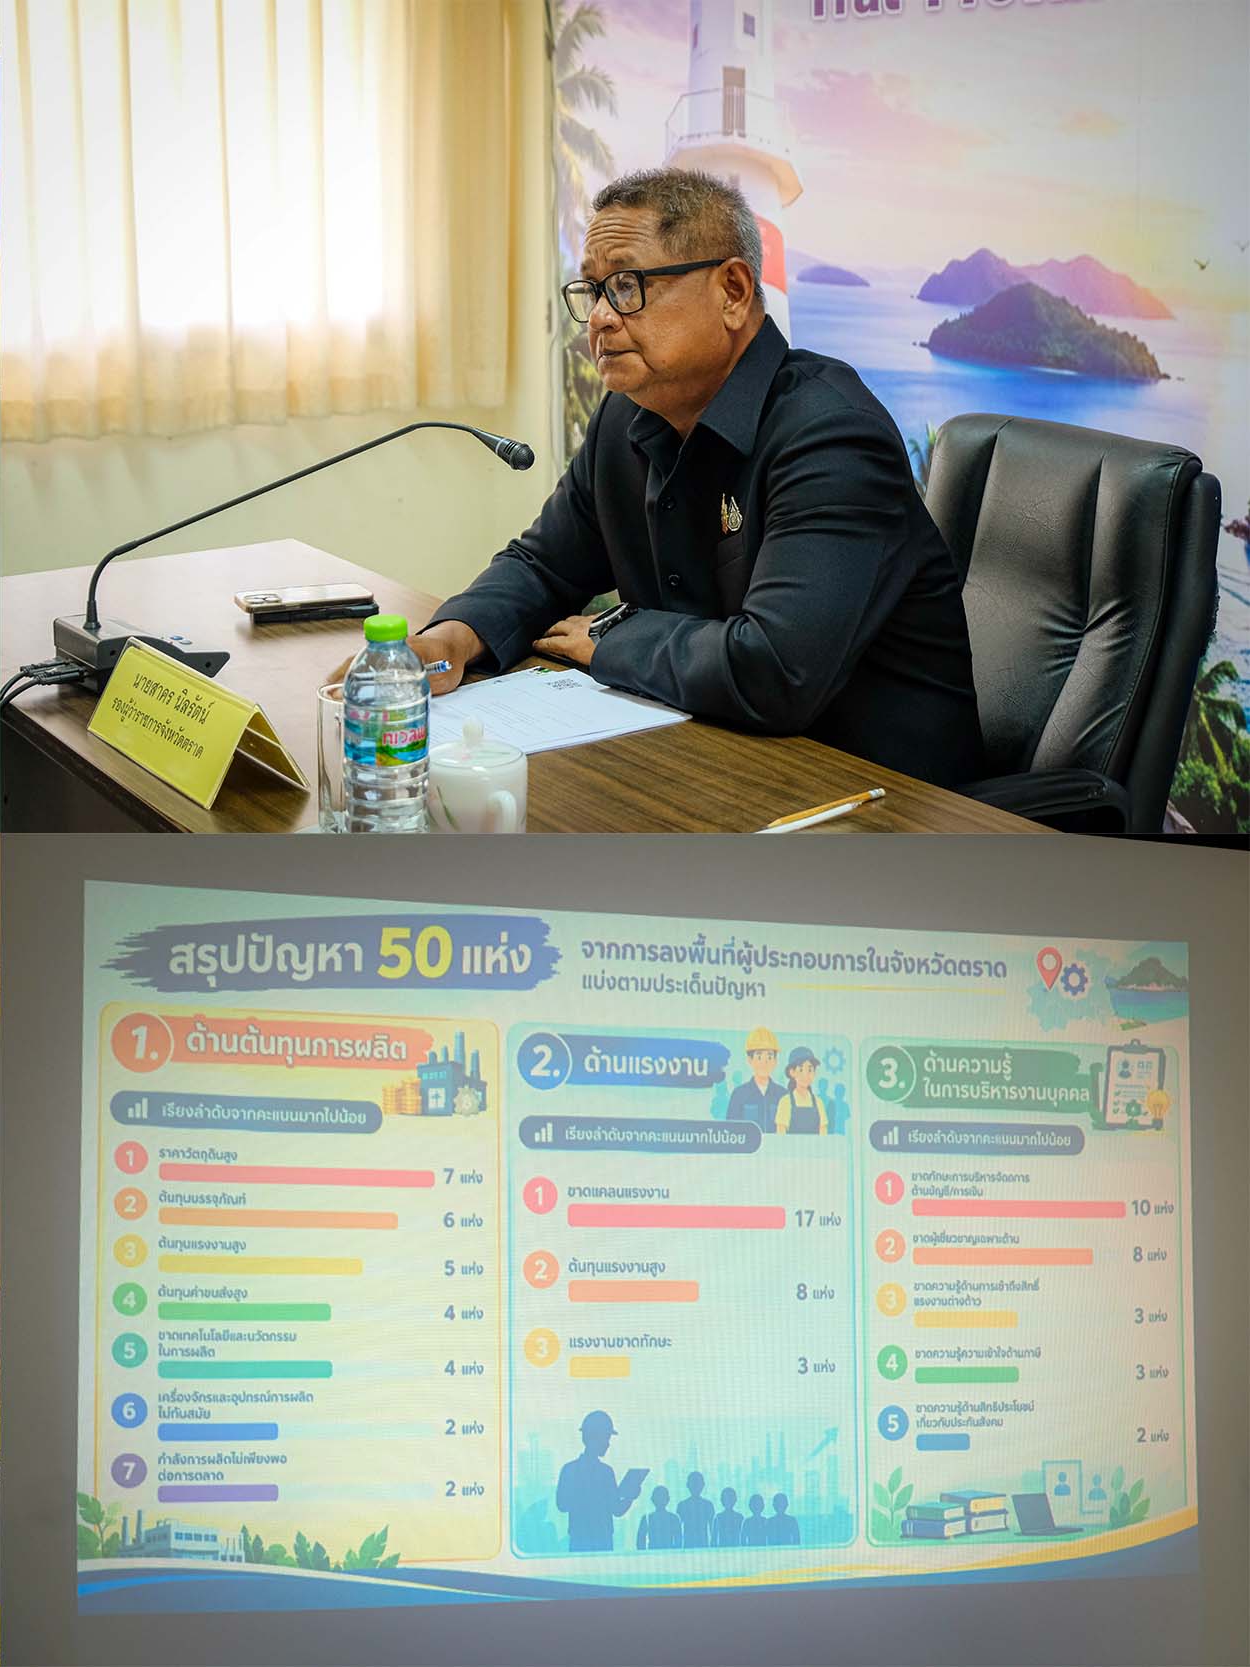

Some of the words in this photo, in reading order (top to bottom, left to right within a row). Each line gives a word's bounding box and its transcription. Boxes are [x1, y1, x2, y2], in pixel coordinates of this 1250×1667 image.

[133, 673, 175, 705] นายสาคร
[174, 688, 216, 724] นิลรัตน์
[111, 697, 204, 759] รองผู้ว่าราชการจังหวัดตราด
[170, 933, 363, 987] สรุปปัญหา
[377, 926, 453, 979] 50
[462, 931, 532, 976] แห่ง
[581, 933, 1007, 978] จากการลงพื้นที่ผู้ประกอบการในจังหวัดตราด
[582, 969, 766, 1000] แบ่งตามประเด็นปัญหา
[131, 1025, 159, 1060] 1.
[186, 1022, 408, 1065] ด้านต้นทุนการผลิต
[530, 1044, 560, 1077] 2.
[584, 1046, 708, 1077] ด้านแรงงาน
[924, 1050, 1013, 1081] ด้านความรู้
[878, 1057, 905, 1089] 3.
[923, 1077, 1090, 1107] ในการบริหารงานบุคคล
[161, 1102, 366, 1125] เรียงลำดับจากคะแนนมากไปน้อย
[565, 1127, 746, 1145] เรียงลำดับจากคะแนนมากไปน้อย
[908, 1129, 1071, 1147] เรียงลำดับจากคะแนนมากไปน้อย
[126, 1150, 135, 1166] 1
[159, 1147, 238, 1164] ราคาวัตถุดิบสูง
[443, 1168, 454, 1184] 7
[460, 1169, 483, 1184] แห่ง
[885, 1179, 893, 1197] 1
[912, 1171, 1030, 1183] ขาดทักษะการบริหารจัดการ
[534, 1186, 543, 1206] 1
[568, 1185, 670, 1199] ขาดแคลนแรงงาน
[912, 1185, 983, 1198] ด้านบัญชี/การเงิน
[124, 1196, 137, 1213] 2
[158, 1190, 247, 1208] ต้นทุนบรรจุภัณฑ์
[1132, 1199, 1151, 1216] 10
[1154, 1200, 1174, 1215] แห่ง
[443, 1212, 455, 1228] 6
[460, 1213, 483, 1227] แห่ง
[795, 1210, 815, 1228] 17
[819, 1211, 842, 1227] แห่ง
[124, 1242, 136, 1259] 3
[158, 1236, 247, 1254] ต้นทุนแรงงานสูง
[885, 1238, 896, 1256] 2
[913, 1230, 1020, 1246] ขาดผู้เชี่ยวชาญเฉพาะด้าน
[1133, 1246, 1143, 1262] 8
[1147, 1248, 1167, 1261] แห่ง
[444, 1260, 455, 1276] 5
[461, 1262, 484, 1275] แห่ง
[534, 1260, 548, 1280] 2
[568, 1258, 666, 1277] ต้นทุนแรงงานสูง
[122, 1291, 136, 1308] 4
[158, 1284, 248, 1302] ต้นทุนค่าขนส่งสูง
[796, 1283, 808, 1300] 8
[813, 1285, 835, 1300] แห่ง
[884, 1291, 897, 1308] 3
[914, 1296, 982, 1307] แรงงานต่างด้าว
[444, 1304, 455, 1320] 4
[461, 1306, 484, 1319] แห่ง
[1135, 1308, 1144, 1324] 3
[1148, 1308, 1167, 1322] แห่ง
[124, 1342, 136, 1359] 5
[158, 1328, 297, 1343] ขาดเทคโนโลยีและนวัตกรรม
[158, 1344, 216, 1358] ในการผลิต
[535, 1338, 548, 1358] 3
[569, 1333, 672, 1349] แรงงานขาดทักษะ
[444, 1360, 456, 1376] 4
[461, 1361, 484, 1375] แห่ง
[797, 1357, 808, 1374] 3
[814, 1358, 836, 1374] แห่ง
[885, 1353, 898, 1371] 4
[1136, 1364, 1145, 1380] 3
[1150, 1365, 1168, 1378] แห่ง
[122, 1402, 136, 1419] 6
[158, 1388, 314, 1406] เครื่องจักรและอุปกรณ์การผลิต
[158, 1406, 211, 1420] ไม่ทันสมัย
[445, 1419, 456, 1435] 2
[462, 1420, 484, 1435] แห่ง
[887, 1414, 898, 1432] 5
[1137, 1427, 1146, 1442] 2
[1150, 1428, 1169, 1442] แห่ง
[122, 1462, 136, 1480] 7
[158, 1451, 287, 1466] กำลังการผลิตไม่เพียงพอ
[158, 1468, 224, 1481] ต่อการตลาด
[445, 1480, 456, 1497] 2
[462, 1482, 485, 1496] แห่ง
